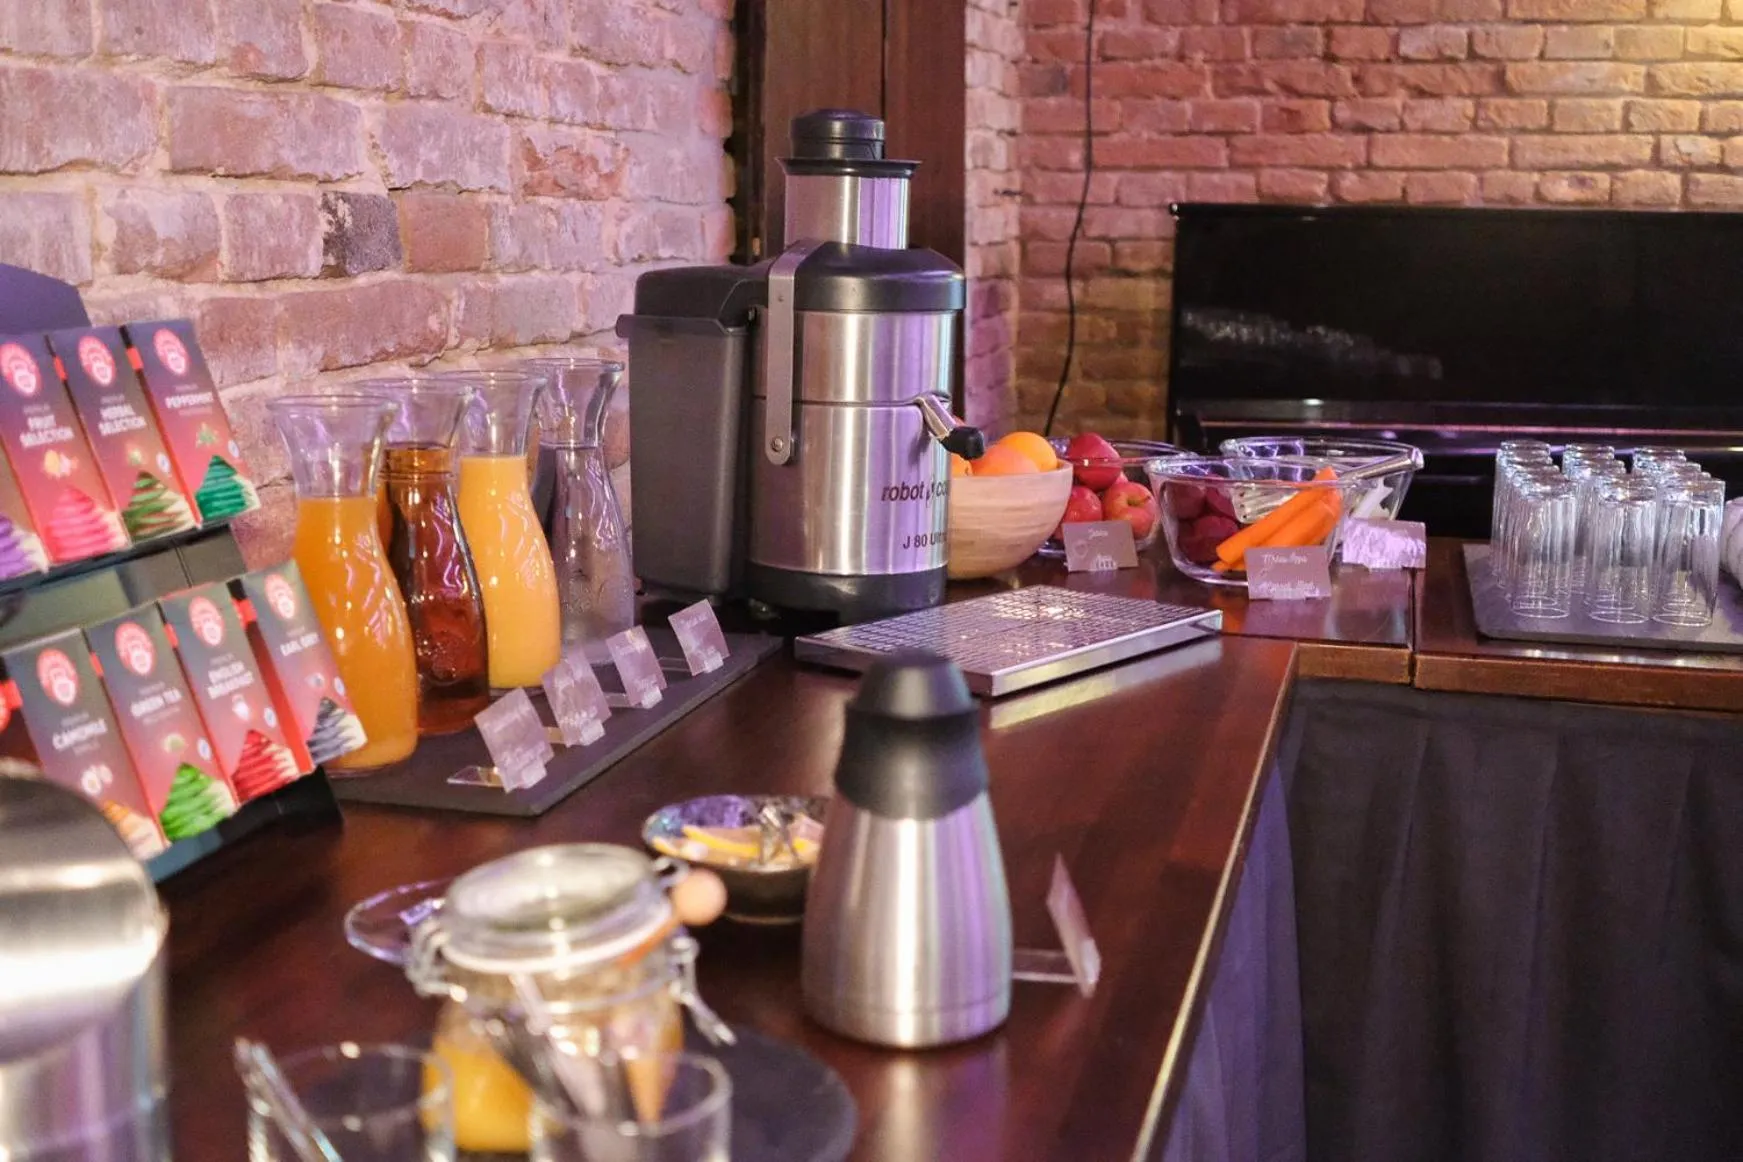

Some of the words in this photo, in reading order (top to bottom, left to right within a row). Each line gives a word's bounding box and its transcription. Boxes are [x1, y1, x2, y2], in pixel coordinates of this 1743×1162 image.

[20, 427, 75, 448] SELECTION
[882, 481, 924, 502] robot
[903, 536, 911, 549] J
[914, 534, 928, 548] 80
[131, 695, 163, 718] GREEN
[163, 687, 182, 706] TEA
